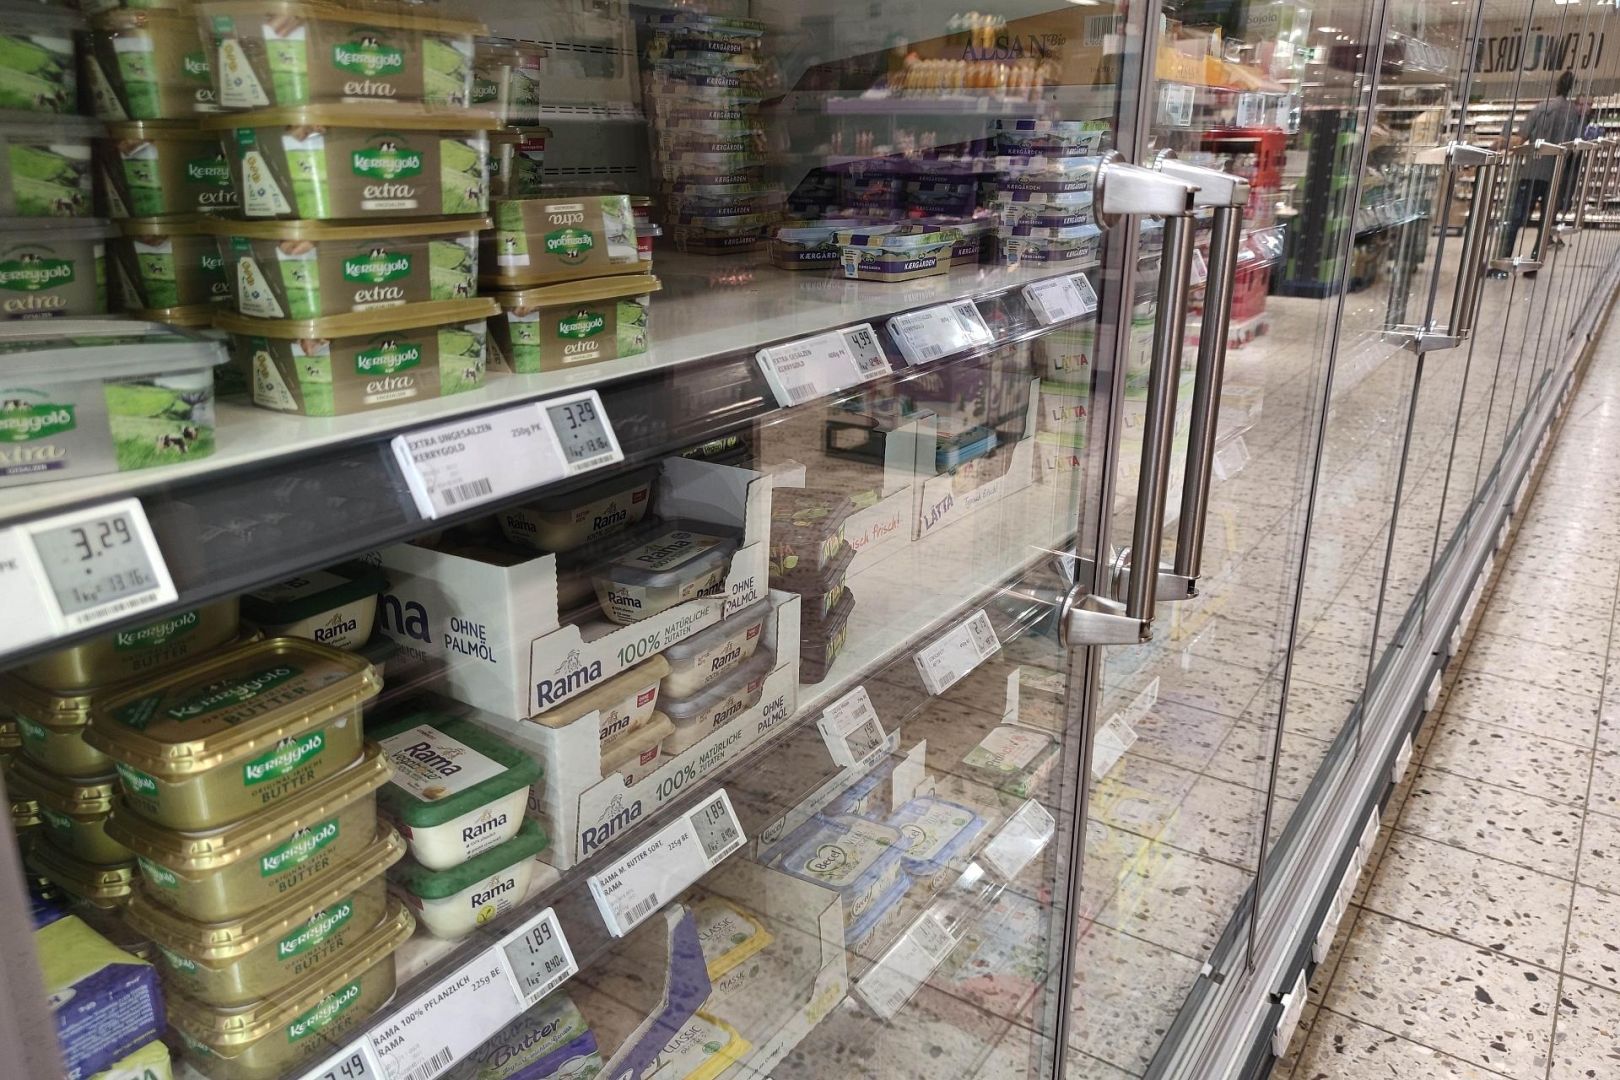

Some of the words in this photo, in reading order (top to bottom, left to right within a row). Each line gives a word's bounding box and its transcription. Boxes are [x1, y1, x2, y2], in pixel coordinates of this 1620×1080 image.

[335, 47, 403, 67] Kerrygold
[962, 34, 1047, 61] ALSAN
[344, 80, 396, 97] extra
[354, 153, 420, 173] Kerrygold
[364, 183, 414, 200] extra
[345, 258, 409, 277] Kerrygold
[904, 257, 936, 271] KÆRGÅRDEN
[3, 294, 67, 313] extra
[353, 286, 404, 303] extra
[559, 317, 603, 334] Kerrygold
[564, 340, 599, 355] extra
[851, 331, 872, 350] 4.99
[358, 350, 419, 369] Kerrygold
[366, 376, 414, 394] extra
[563, 401, 596, 430] 3.29
[408, 436, 437, 452] EXTRA
[437, 423, 492, 444] UNGESALZEN
[511, 426, 531, 438] 250g
[413, 442, 466, 464] KERRYGOLD
[506, 515, 537, 534] Rama
[593, 509, 627, 531] Rama
[922, 492, 954, 531] LÄTTA
[69, 516, 132, 562] 3.29
[872, 511, 902, 541] frisch!
[637, 538, 692, 564] Rama
[732, 576, 755, 595] OHNE
[607, 591, 642, 609] Rama
[117, 611, 197, 646] Kerrygold
[315, 617, 357, 643] Rama
[449, 616, 487, 642] OHNE
[616, 633, 661, 668] 100%
[664, 605, 710, 635] NATÜRLICHE
[664, 626, 692, 646] ZUTATEN
[444, 633, 498, 664] PALMÖL
[711, 646, 741, 672] Rama
[167, 667, 291, 718] Kerrygold
[536, 659, 602, 708] Rama
[223, 685, 309, 725] BUTTER
[712, 699, 743, 728] Rama
[762, 695, 785, 718] OHNE
[599, 715, 630, 741] ama
[757, 707, 788, 735] PALMÖL
[246, 734, 323, 780] Kerrygold
[404, 741, 462, 777] Rama
[655, 761, 696, 802] 100%
[699, 728, 743, 764] NATÜRLICHE
[698, 750, 726, 775] ZUTATEN
[261, 770, 316, 804] BUTTER
[705, 800, 726, 826] 1.89
[462, 813, 508, 842] Rama
[581, 799, 642, 856] Rama
[263, 823, 336, 872] Kerrygold
[815, 850, 842, 871] Becel
[278, 856, 331, 894] BUTTER
[599, 870, 619, 888] RAMA
[626, 850, 649, 870] BUTTER
[668, 839, 682, 851] 225g
[471, 877, 516, 909] Rama
[603, 880, 623, 897] RAMA
[280, 904, 351, 956] Kerrygold
[525, 921, 552, 954] 1.89
[698, 917, 733, 941] CLASSIC
[294, 936, 345, 976] BUTTER
[289, 984, 359, 1039] Kerrygold
[373, 1024, 401, 1048] RAMA
[400, 1007, 424, 1028] 100%
[423, 974, 471, 1012] PFLANZLICH
[471, 976, 491, 993] 225g
[490, 966, 501, 979] BE
[377, 1035, 406, 1059] RAMA
[487, 1018, 561, 1071] Butter
[662, 1025, 702, 1055] CLASSIC
